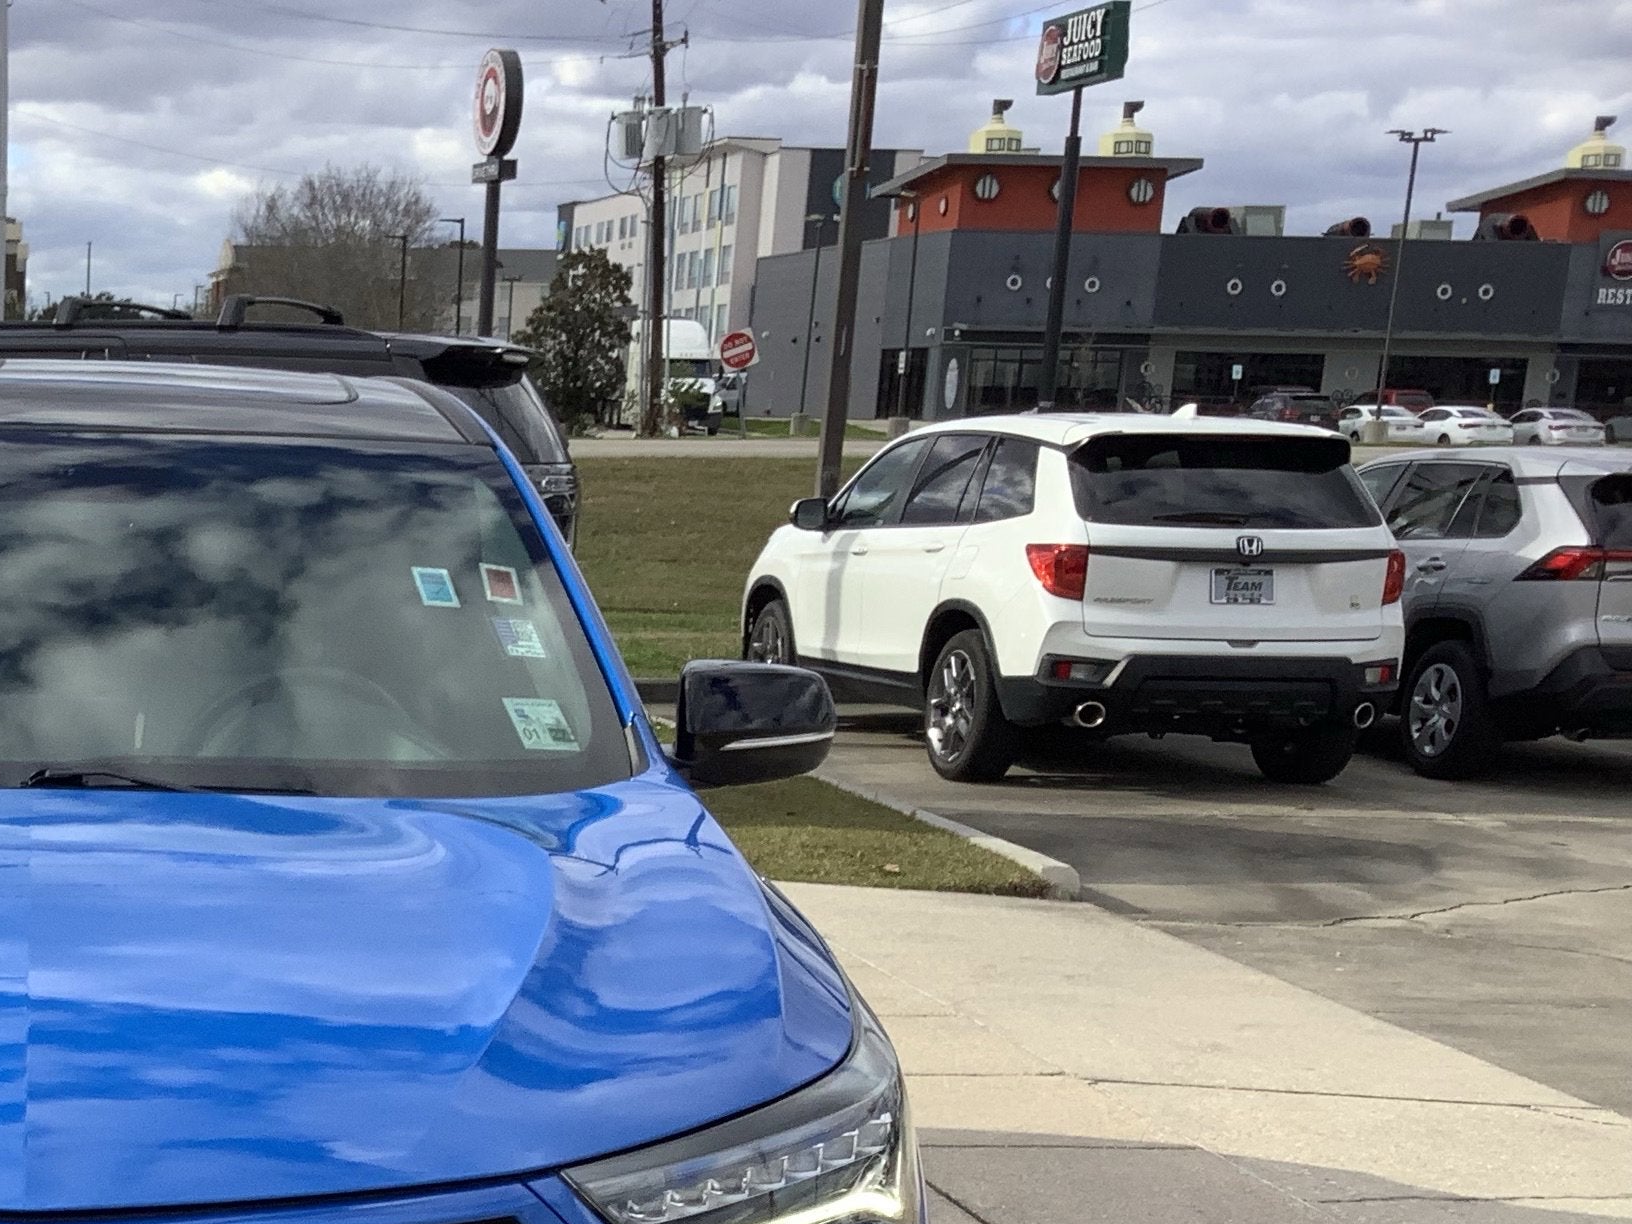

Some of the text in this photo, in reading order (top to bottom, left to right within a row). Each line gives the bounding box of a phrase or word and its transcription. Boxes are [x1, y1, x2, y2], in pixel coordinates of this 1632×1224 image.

[1063, 8, 1105, 46] JUICY
[1061, 38, 1102, 65] SEAFOOD
[723, 336, 748, 350] DO NOT
[730, 352, 750, 364] ENTER
[1225, 576, 1263, 591] TEAM
[523, 728, 541, 740] 01
